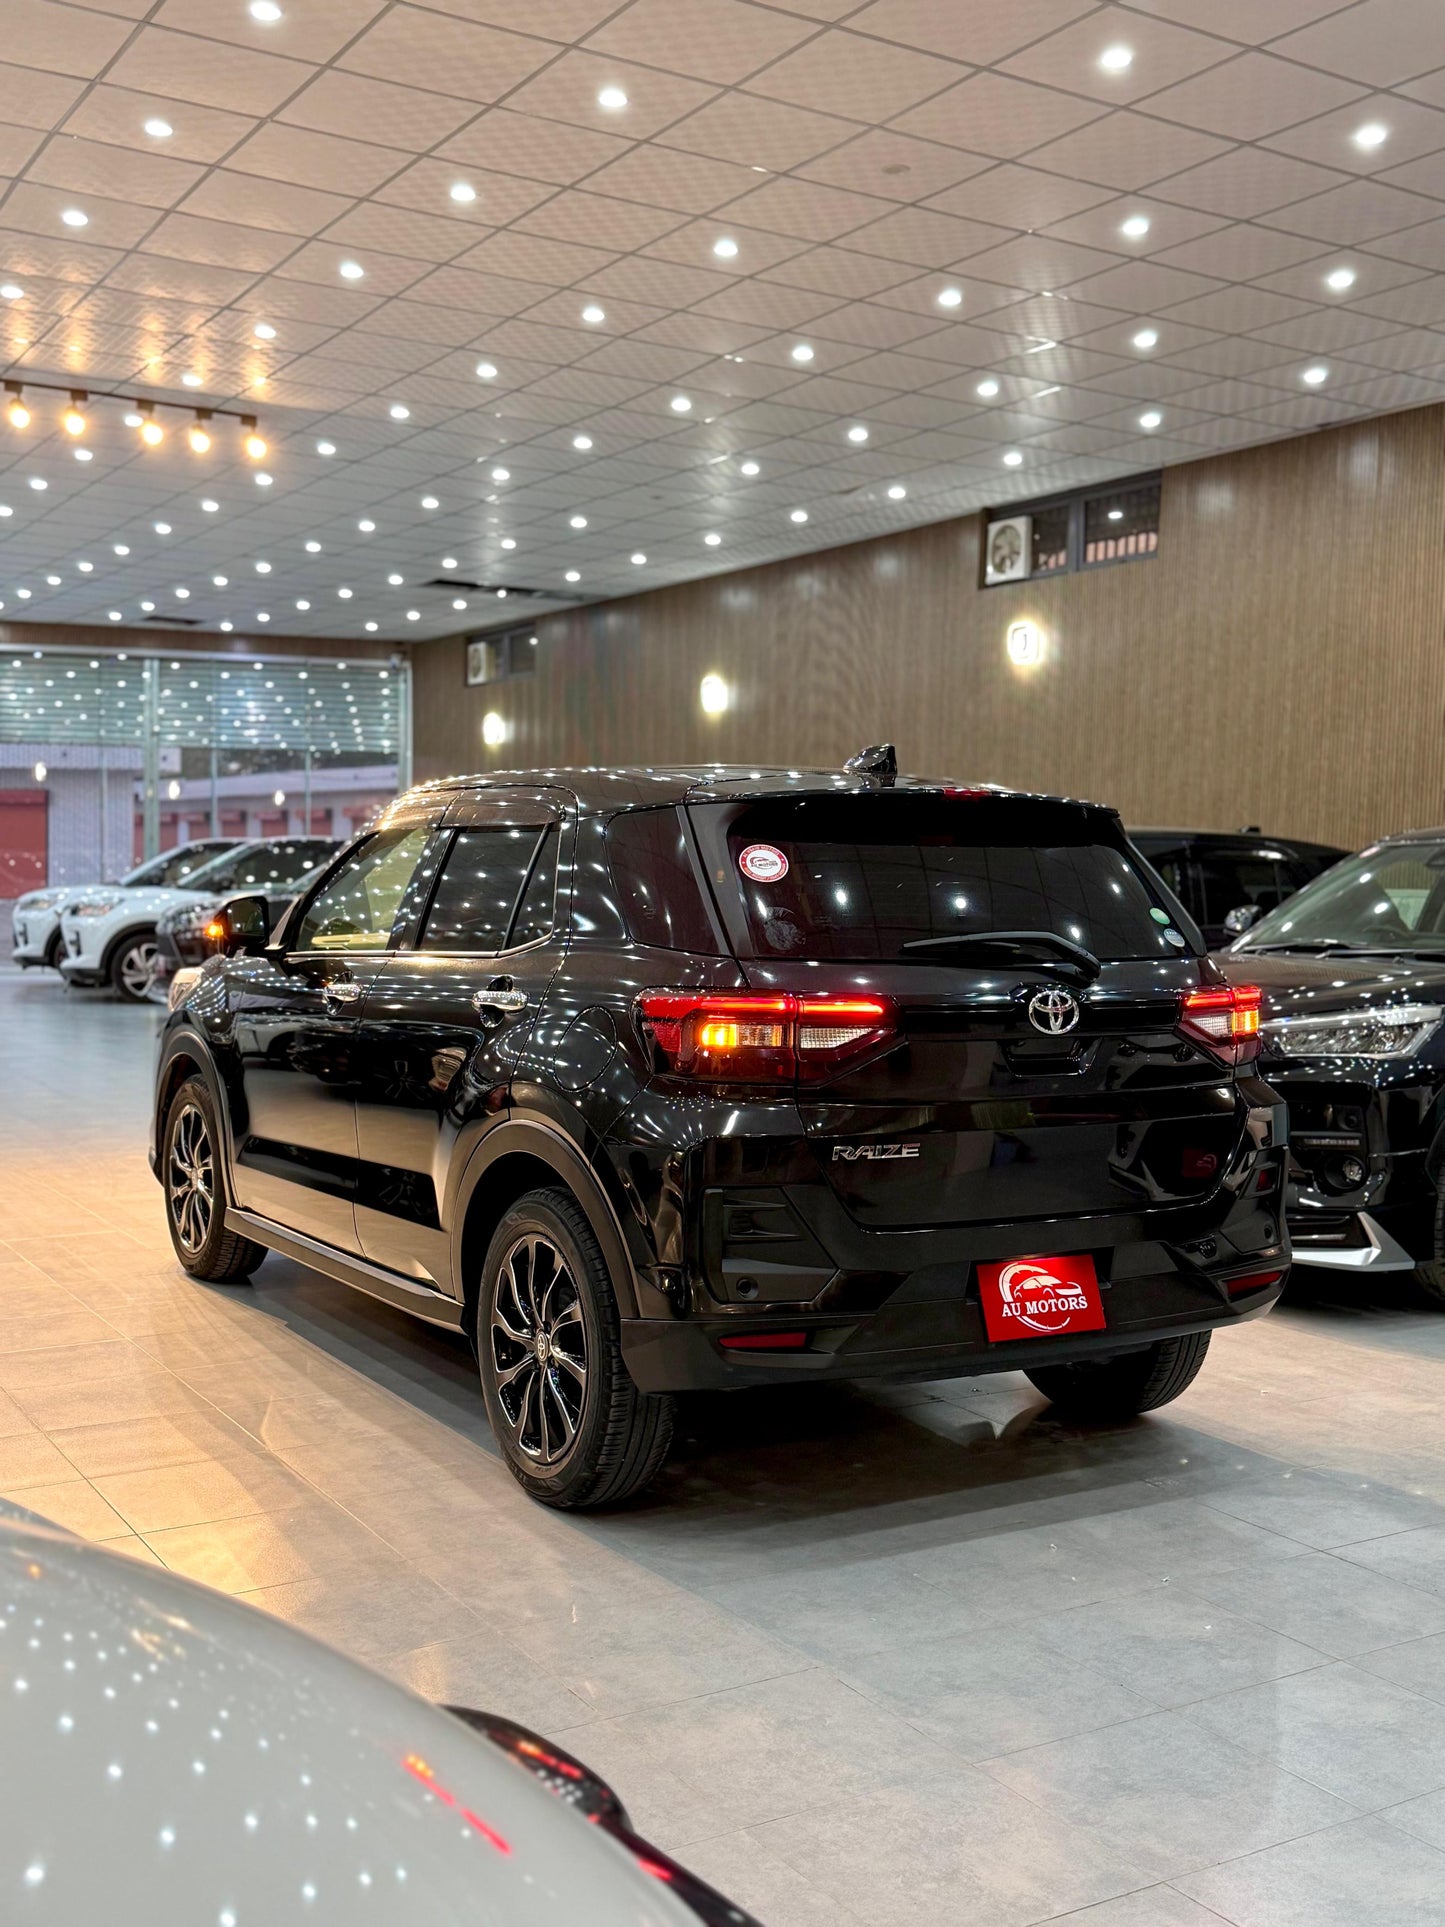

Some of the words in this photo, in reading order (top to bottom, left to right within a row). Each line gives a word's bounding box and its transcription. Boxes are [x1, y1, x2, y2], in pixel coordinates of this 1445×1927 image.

[832, 1143, 920, 1160] RAIZE
[1002, 1302, 1021, 1317] AU
[1025, 1296, 1088, 1314] MOTORS
